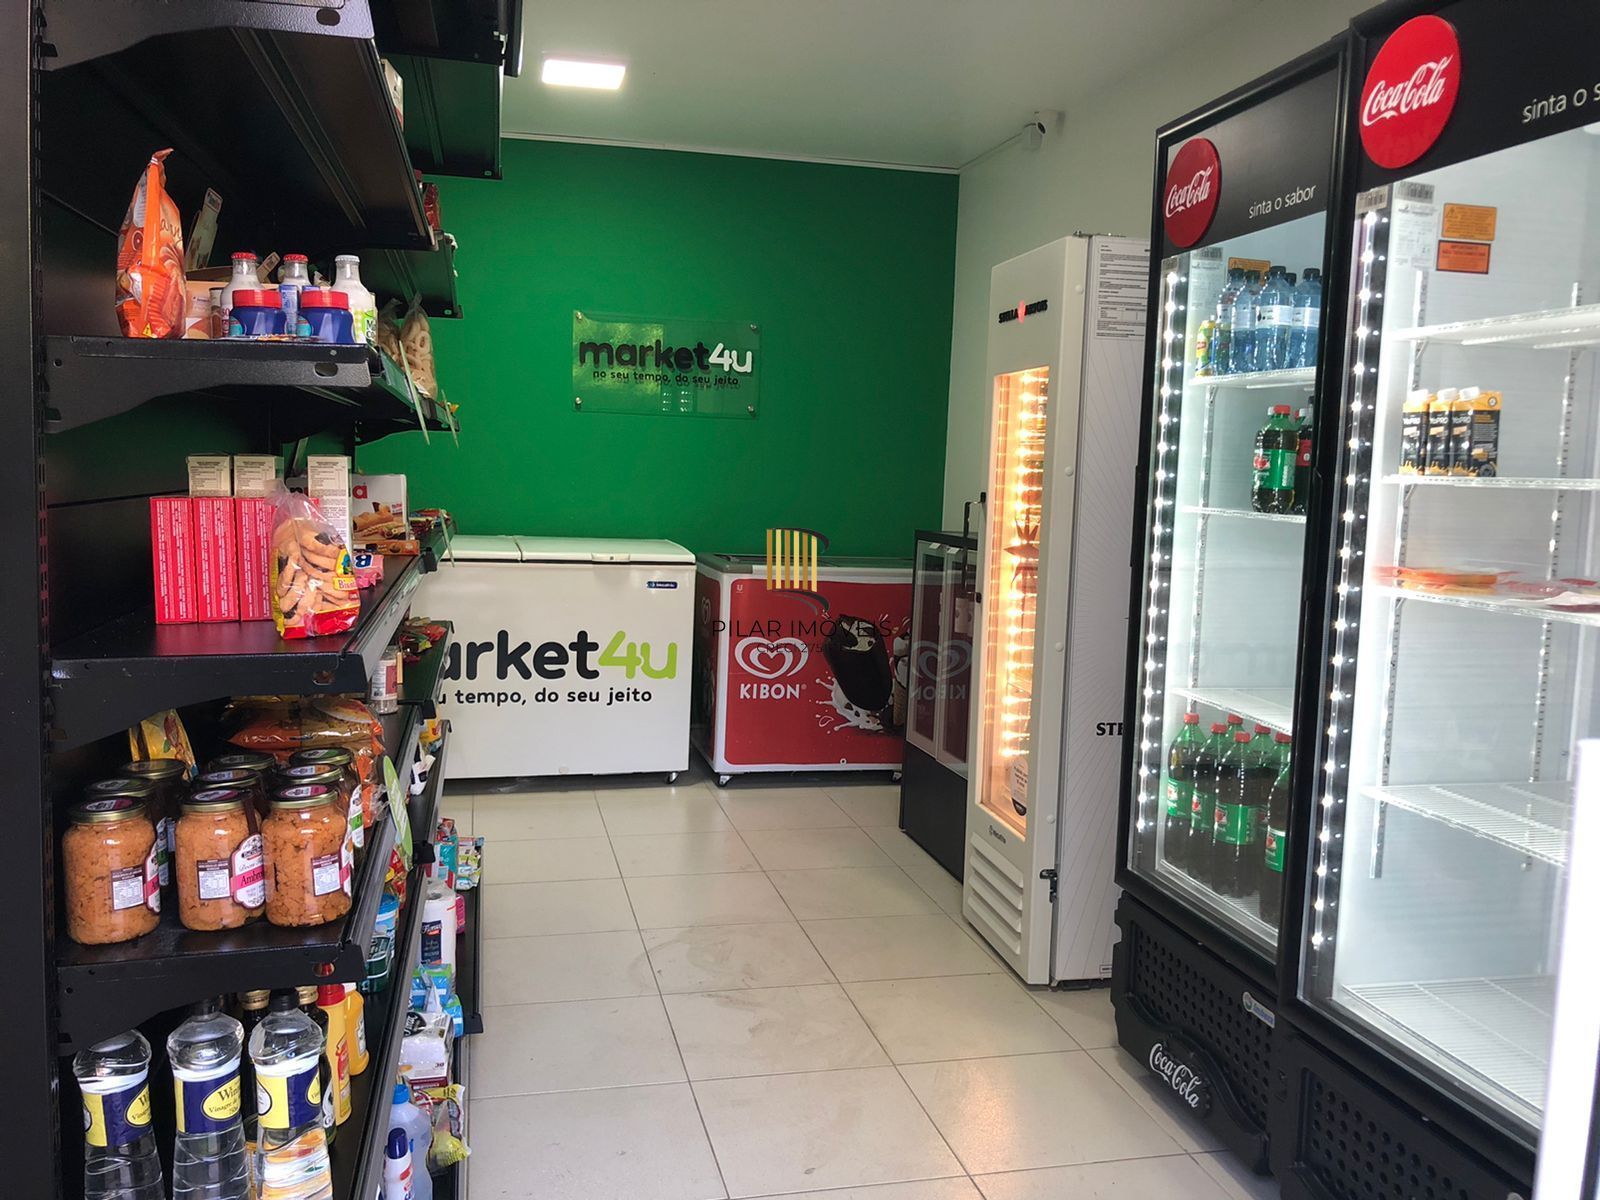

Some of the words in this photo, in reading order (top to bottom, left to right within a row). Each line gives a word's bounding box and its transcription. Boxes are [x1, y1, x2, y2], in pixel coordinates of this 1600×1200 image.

[1362, 53, 1454, 127] Coca-Cola
[1522, 92, 1567, 125] sinta
[1572, 87, 1588, 107] o
[1165, 164, 1214, 219] Coca-Cola
[1248, 199, 1273, 219] sinta
[1274, 197, 1282, 208] o
[1284, 185, 1317, 207] sabor
[579, 339, 753, 374] market4u
[593, 370, 607, 378] no
[611, 371, 629, 380] seu
[633, 370, 671, 384] tempo,
[675, 373, 689, 382] do
[692, 376, 710, 385] seu
[713, 375, 739, 387] jeito
[443, 629, 678, 681] arket4u
[455, 689, 527, 706] tempo,
[534, 687, 559, 703] do
[567, 690, 600, 703] seu
[606, 687, 653, 706] jeito
[739, 683, 801, 700] KIBON
[1150, 1043, 1202, 1108] Coca-Cola
